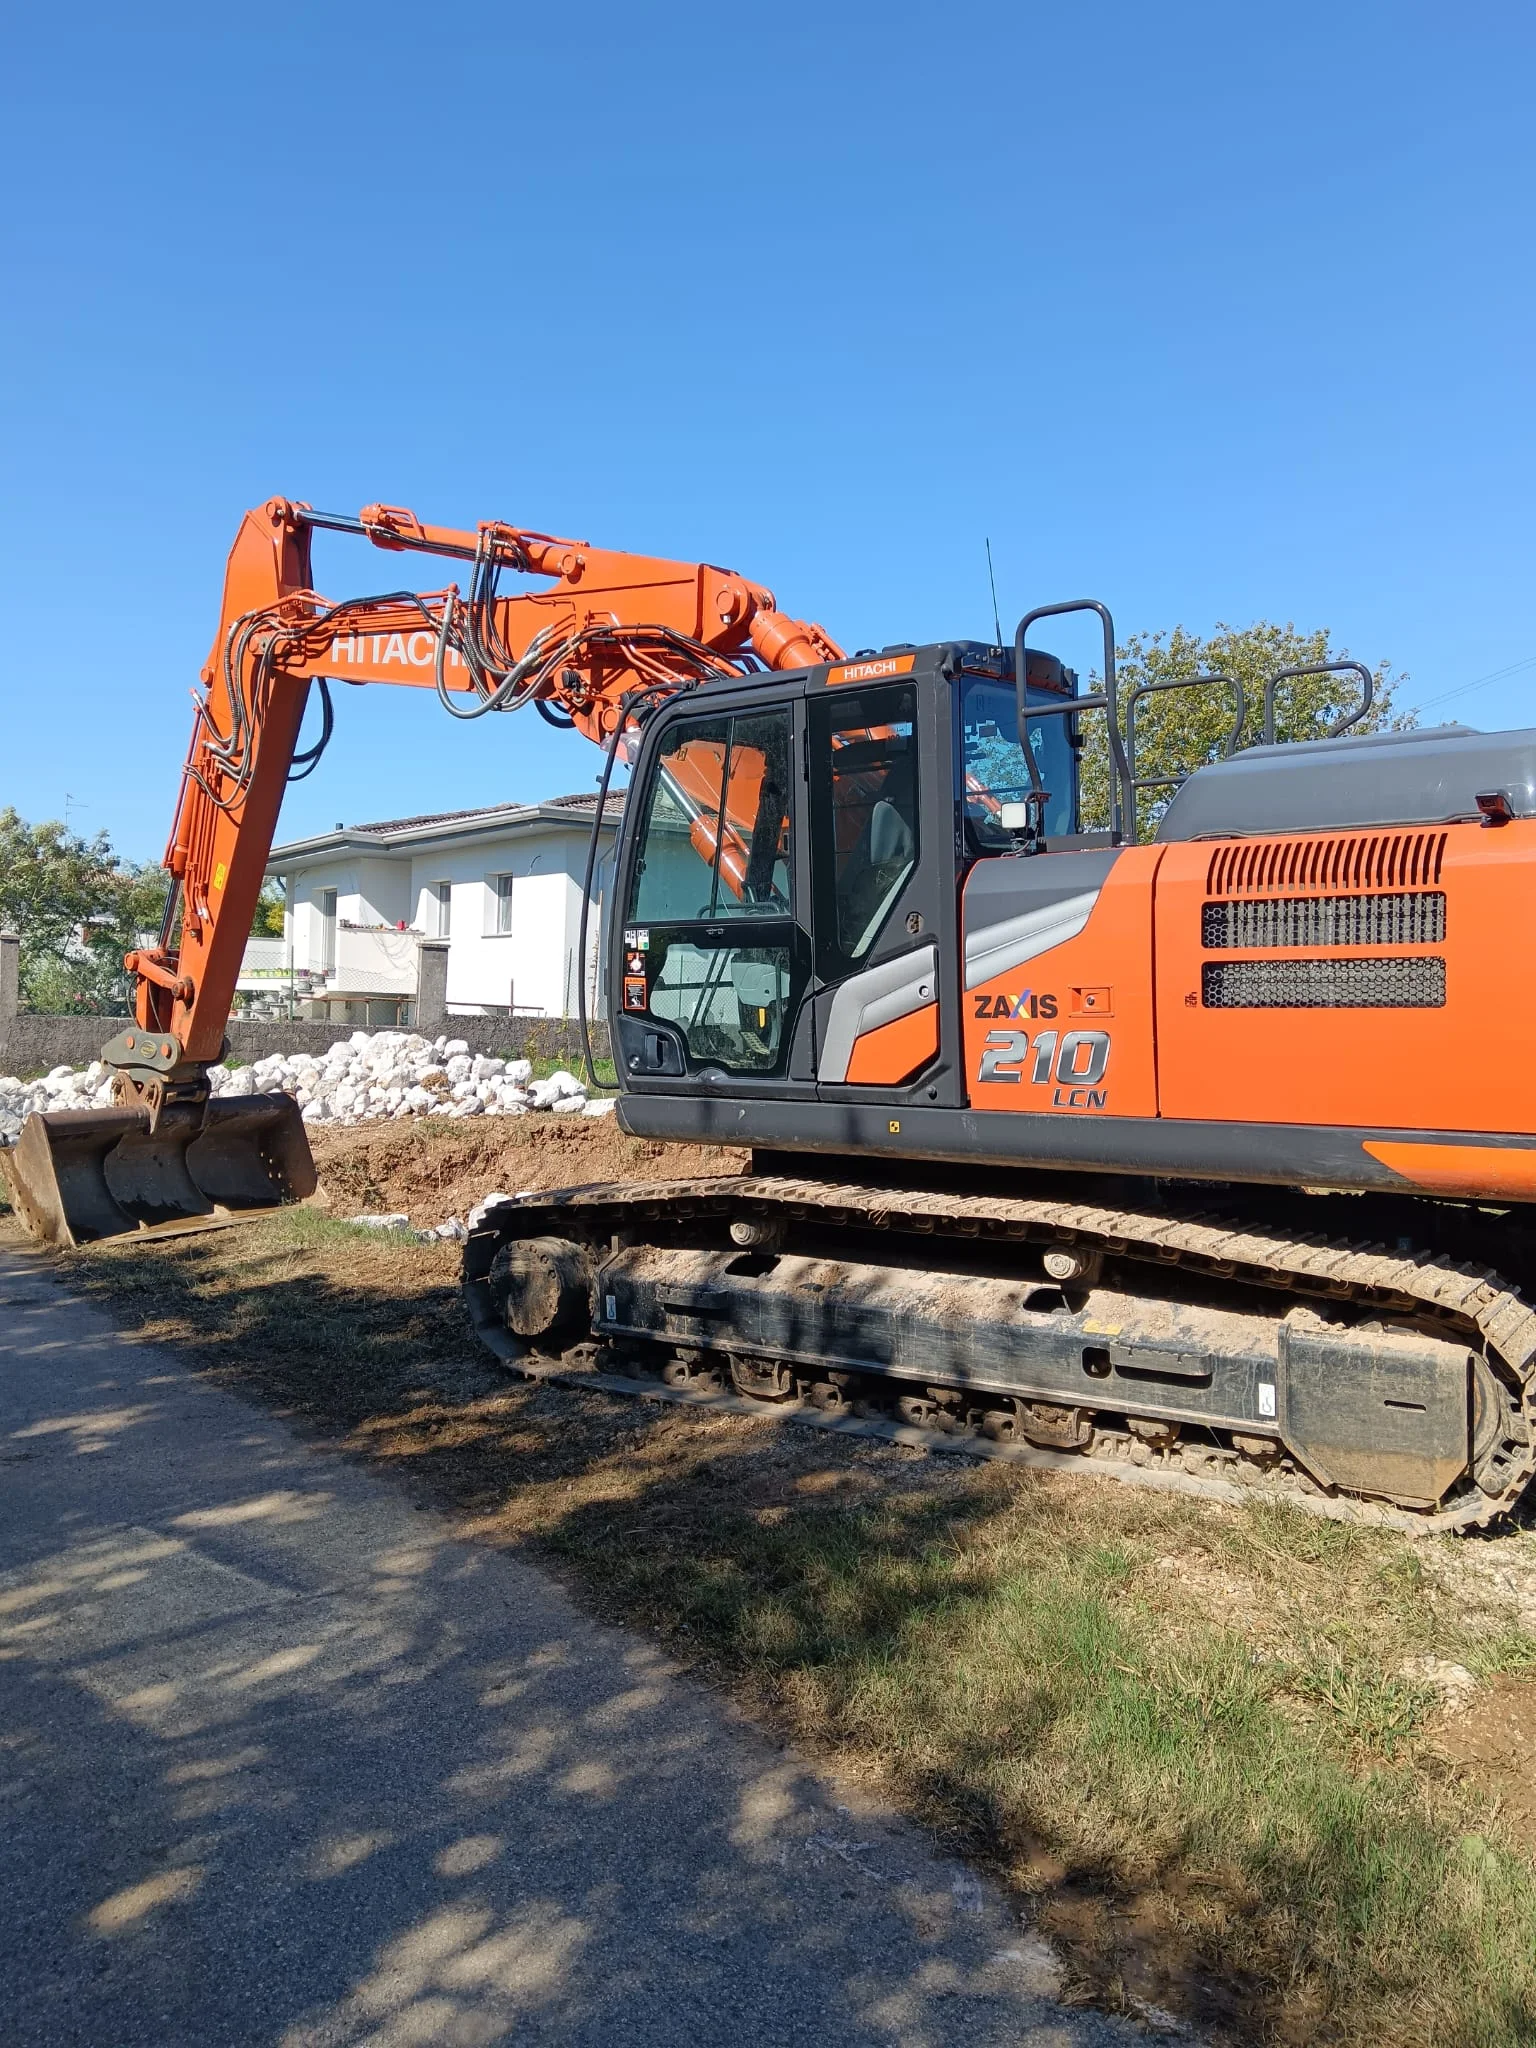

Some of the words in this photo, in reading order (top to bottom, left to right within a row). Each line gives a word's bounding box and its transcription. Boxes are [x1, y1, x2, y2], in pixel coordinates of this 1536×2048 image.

[331, 631, 468, 666] HITACH
[844, 661, 896, 679] HITACHI
[974, 989, 1059, 1019] ZAXIS
[977, 1030, 1111, 1085] 210
[1052, 1088, 1108, 1109] LCN
